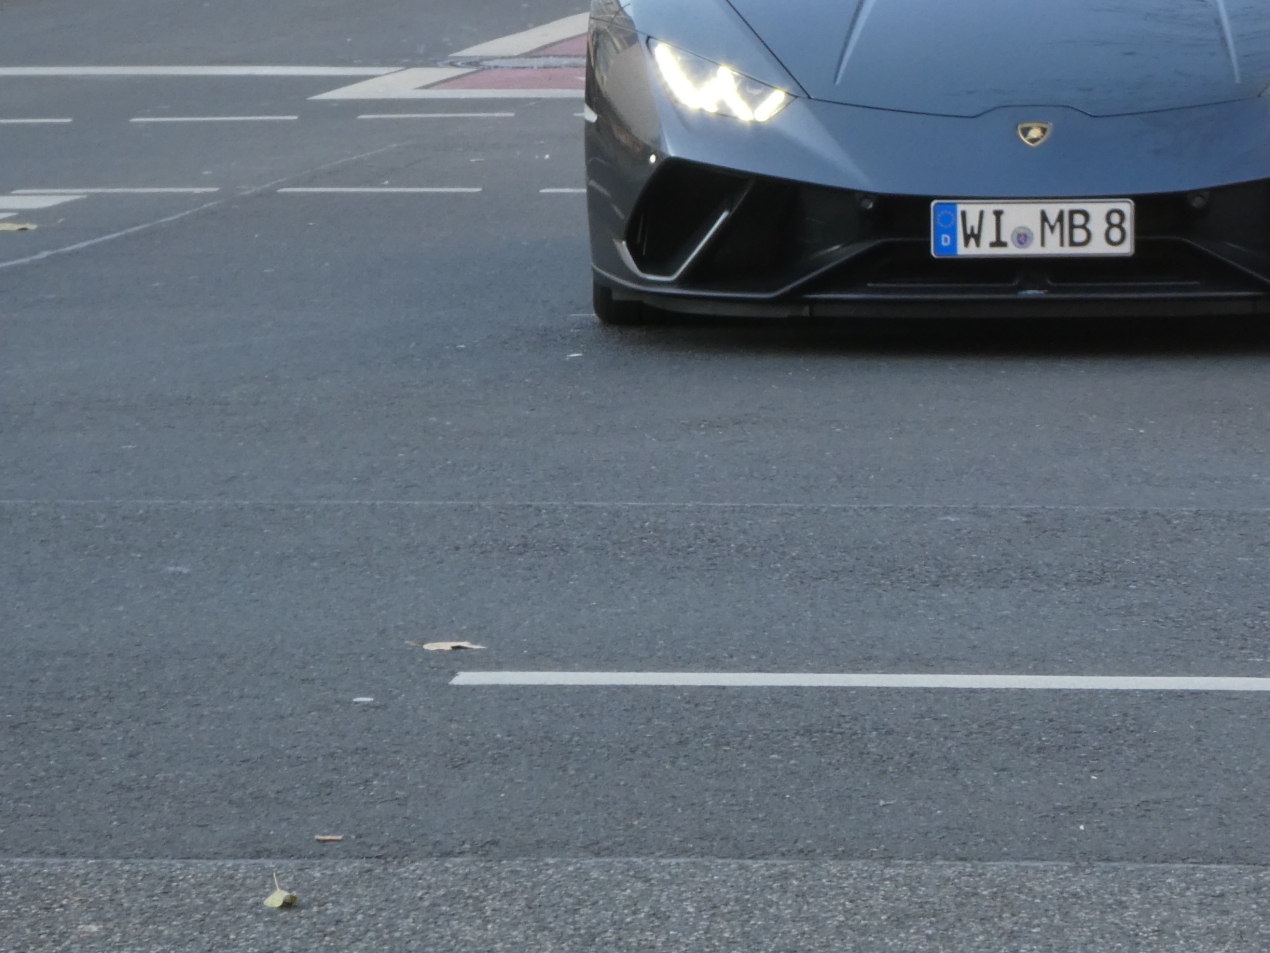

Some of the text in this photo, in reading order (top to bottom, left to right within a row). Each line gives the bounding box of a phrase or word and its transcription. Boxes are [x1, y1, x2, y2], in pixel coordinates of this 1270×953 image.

[960, 208, 1126, 248] WI MB 8
